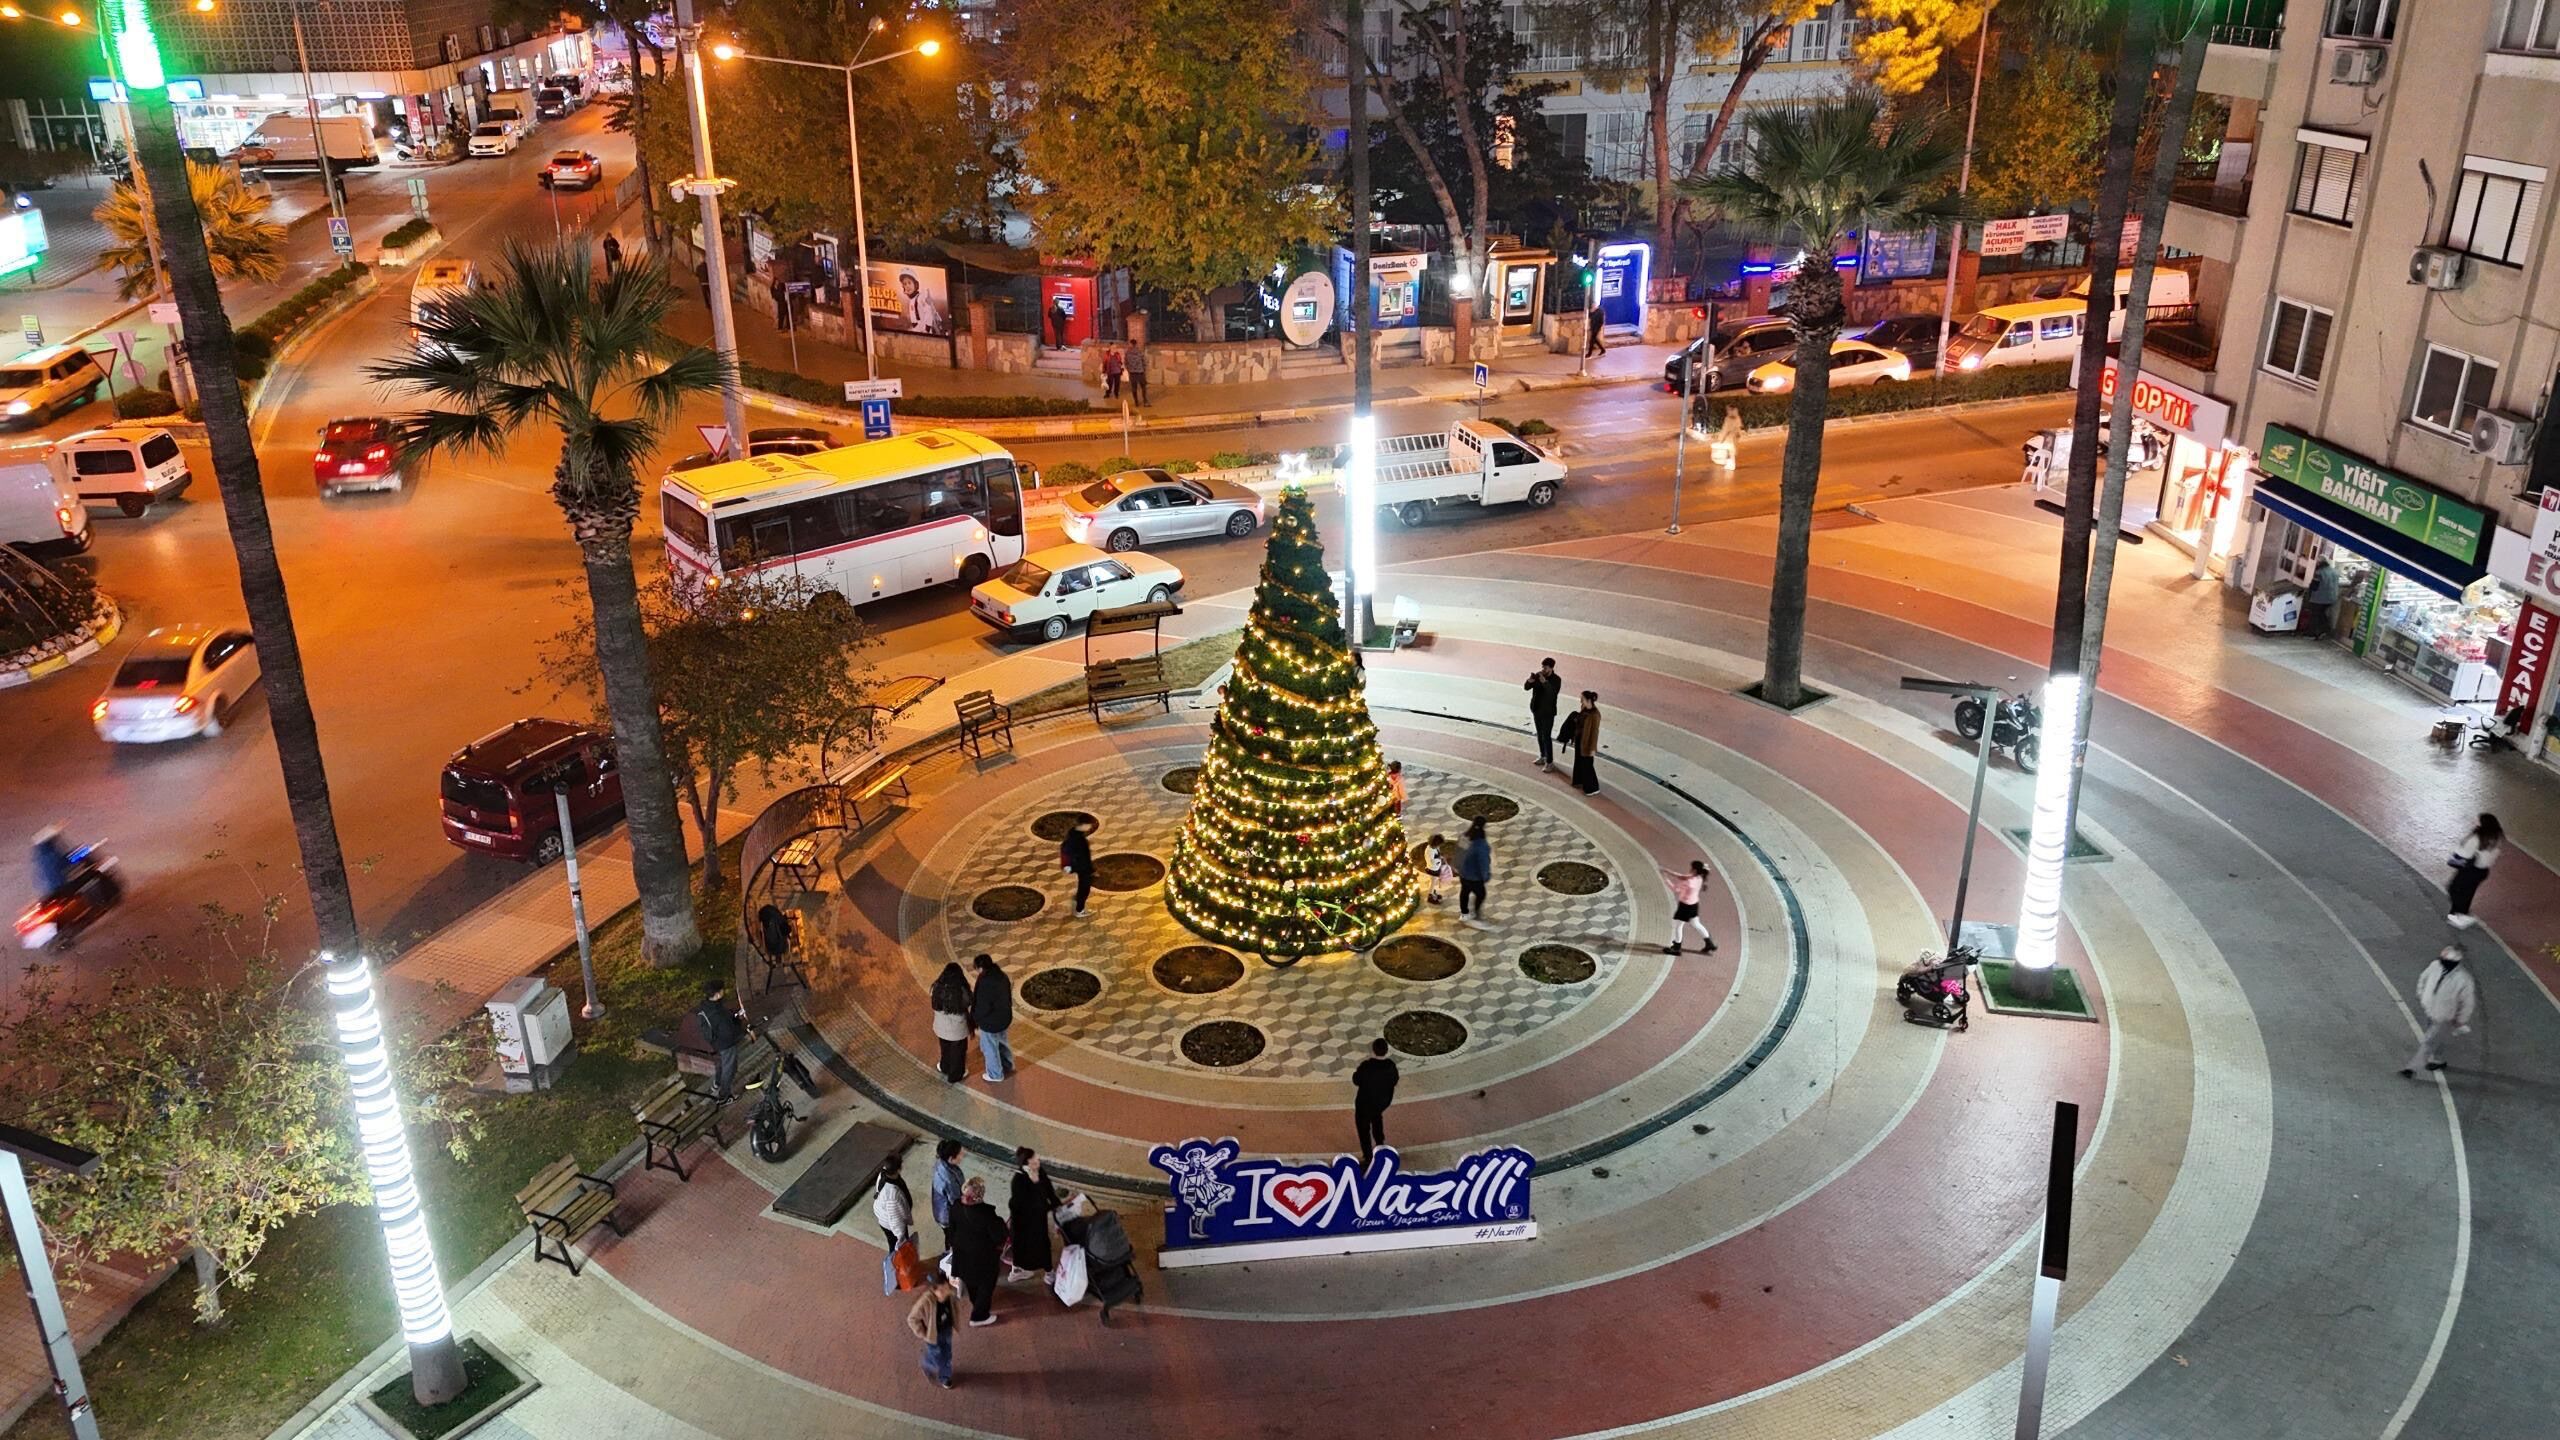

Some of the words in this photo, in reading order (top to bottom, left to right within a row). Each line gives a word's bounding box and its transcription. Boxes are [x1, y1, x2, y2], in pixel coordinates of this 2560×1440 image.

[1996, 221, 2017, 230] HALK
[1373, 261, 1407, 270] DenizBank
[867, 404, 885, 425] H
[2341, 463, 2389, 496] YİĞİT
[2320, 476, 2403, 525] BAHARAT
[2506, 611, 2549, 714] ECZAN
[1233, 1168, 1277, 1226] I
[1316, 1156, 1528, 1229] Nazilli
[1352, 1217, 1385, 1230] Uzun
[1387, 1213, 1429, 1227] Yaşam
[1474, 1224, 1527, 1240] #Nazilli
